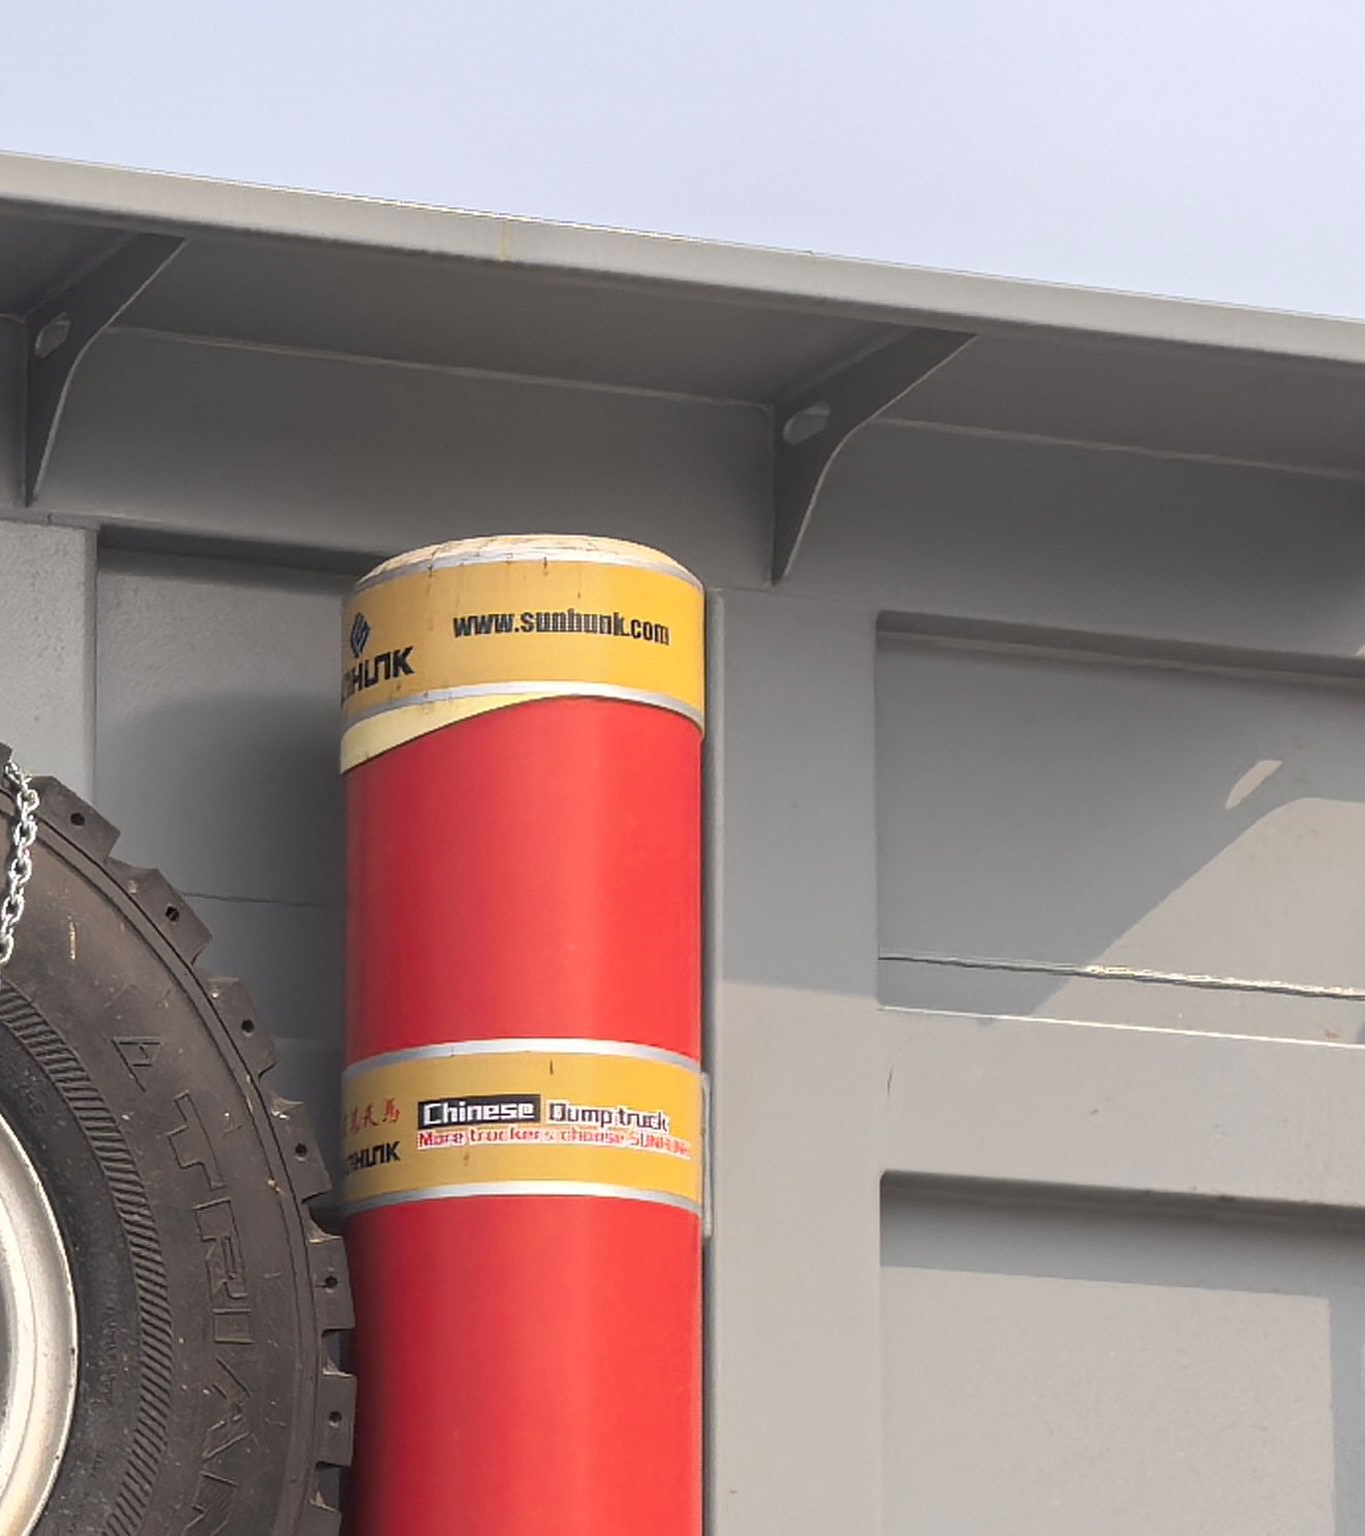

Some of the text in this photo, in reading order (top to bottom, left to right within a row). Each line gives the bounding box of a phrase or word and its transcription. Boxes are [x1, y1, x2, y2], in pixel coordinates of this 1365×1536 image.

[453, 608, 669, 646] www.sunhunk.com
[422, 1101, 535, 1126] Chinese
[549, 1102, 613, 1128] Dump
[419, 1131, 464, 1148] More
